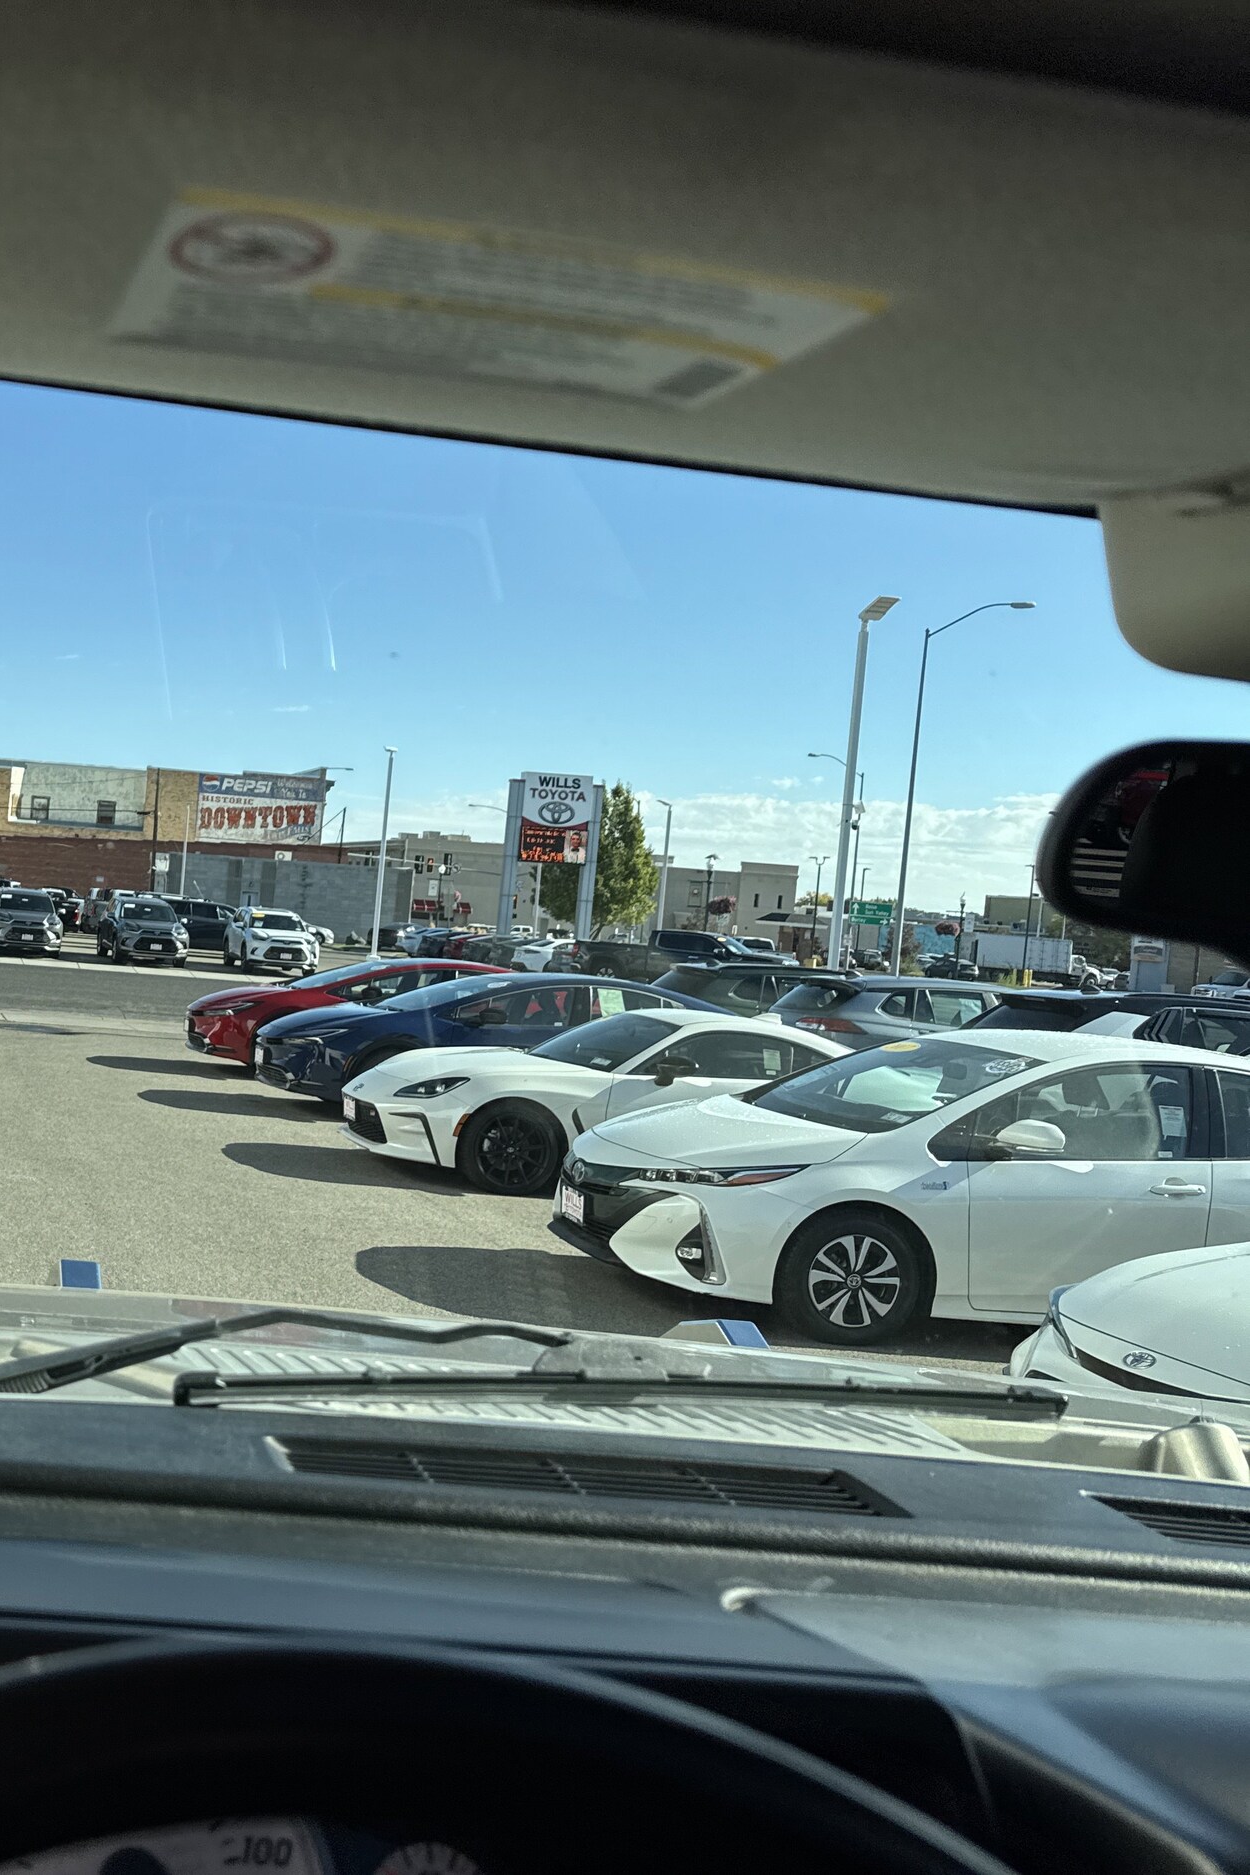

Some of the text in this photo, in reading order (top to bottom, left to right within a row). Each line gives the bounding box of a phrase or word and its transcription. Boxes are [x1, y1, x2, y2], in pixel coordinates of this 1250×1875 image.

[221, 777, 273, 794] PEPSI
[538, 775, 581, 789] WILLS
[202, 794, 254, 806] HISTORIC
[530, 788, 586, 802] TOYOTA
[199, 804, 317, 830] DOWNTOWN
[243, 1836, 293, 1866] 100
